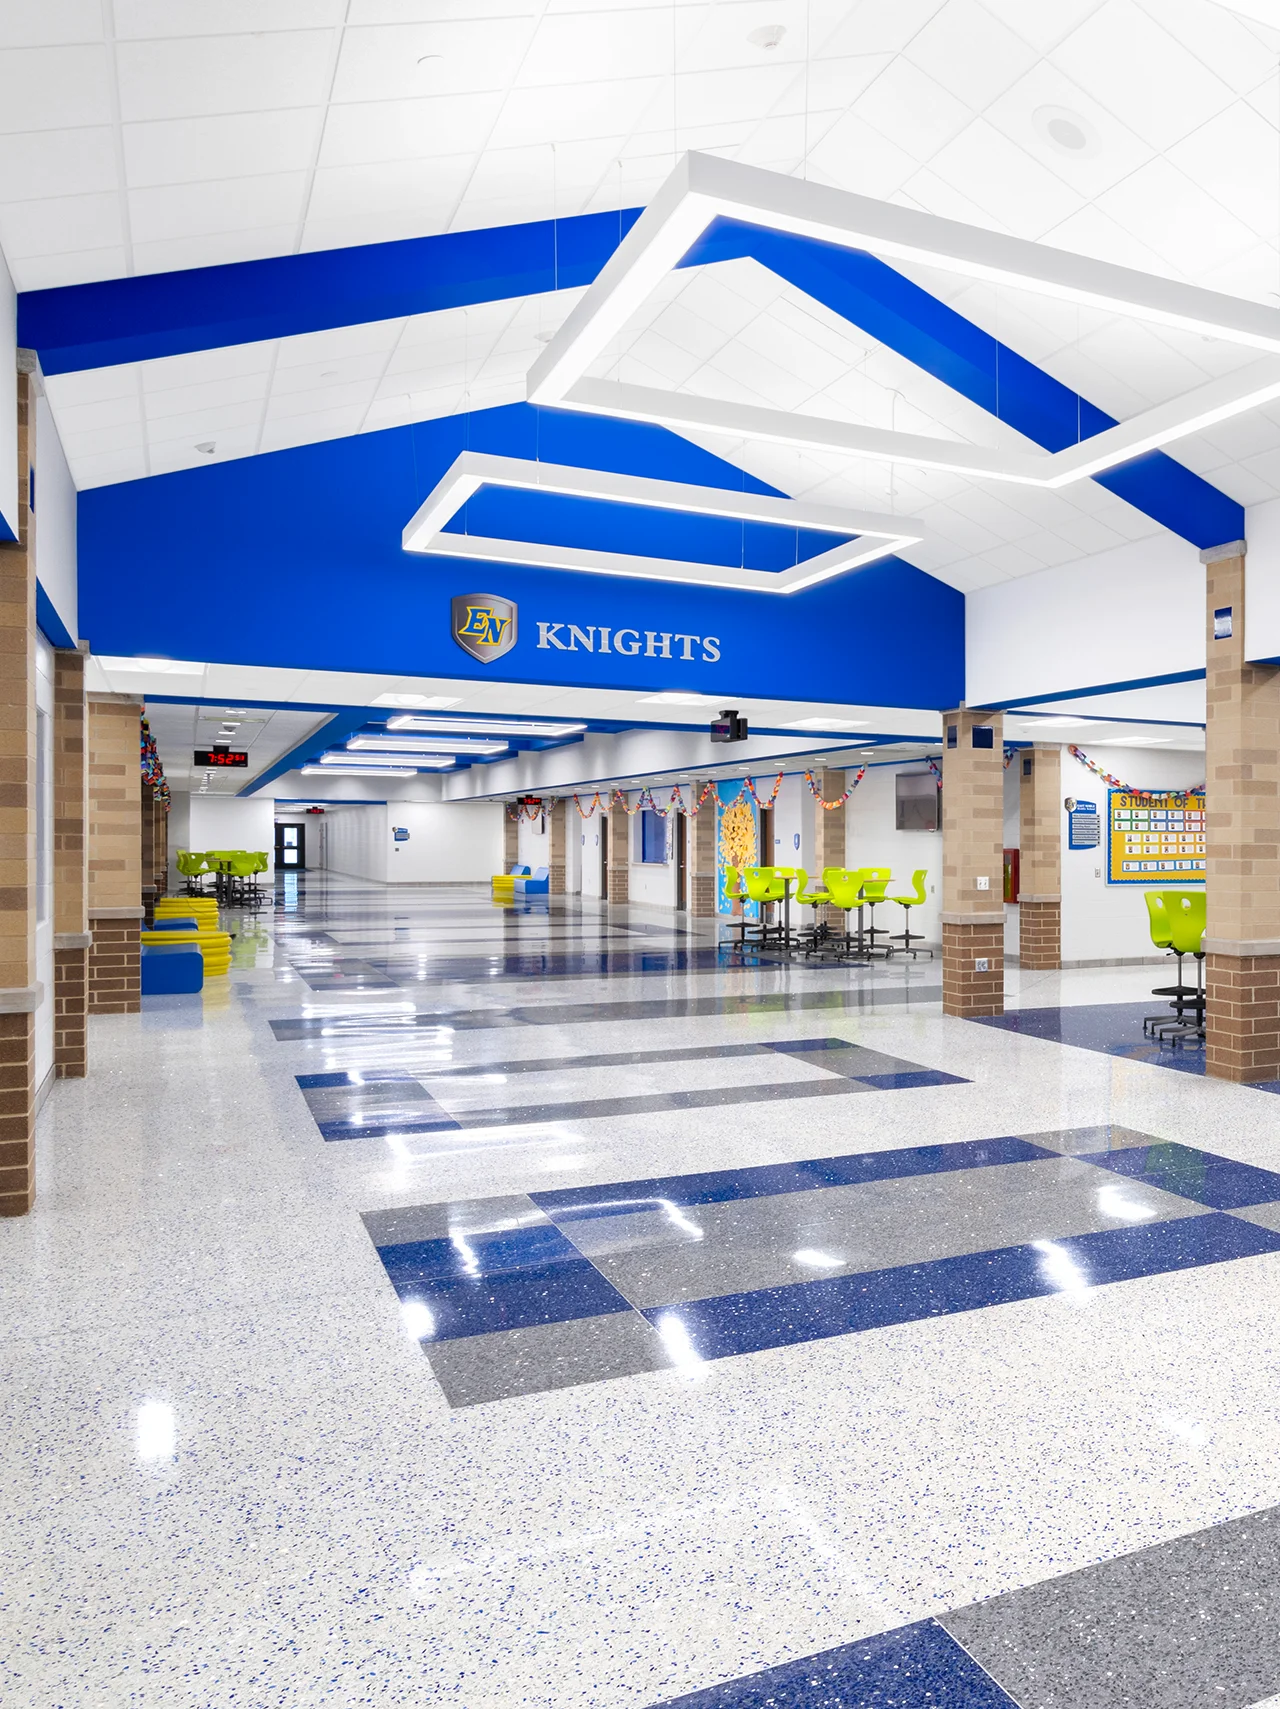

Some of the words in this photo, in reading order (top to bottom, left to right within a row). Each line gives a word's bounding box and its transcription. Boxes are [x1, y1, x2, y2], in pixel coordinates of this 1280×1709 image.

[459, 606, 511, 646] EN
[536, 621, 721, 663] KNIGHTS
[207, 753, 234, 764] 7:52
[1120, 795, 1168, 808] STUDENT
[1174, 798, 1188, 809] OF
